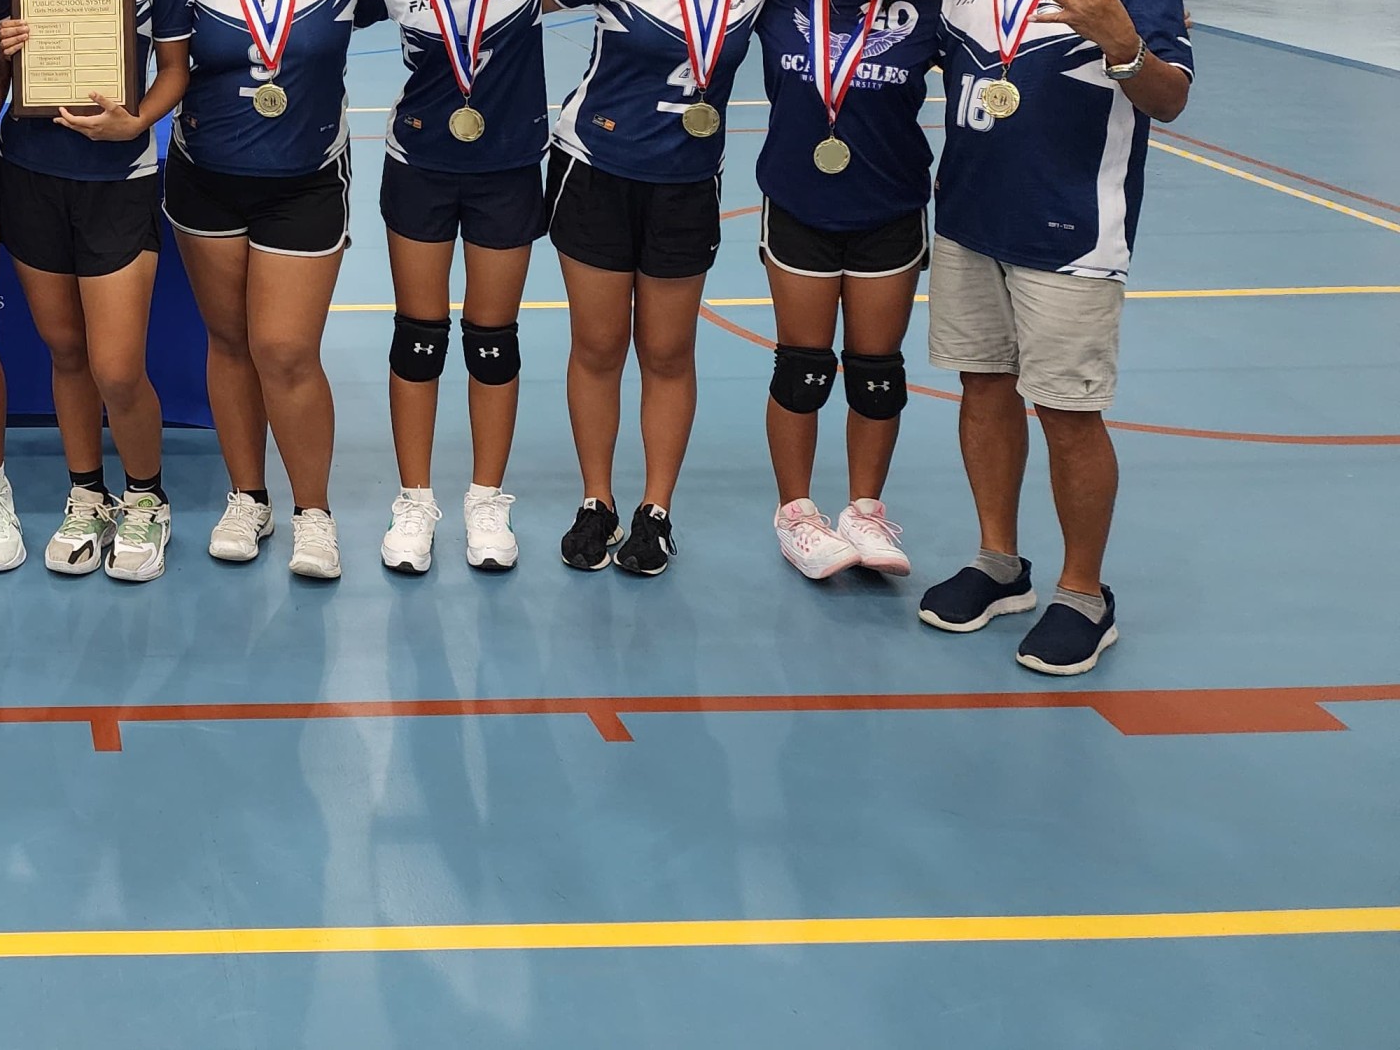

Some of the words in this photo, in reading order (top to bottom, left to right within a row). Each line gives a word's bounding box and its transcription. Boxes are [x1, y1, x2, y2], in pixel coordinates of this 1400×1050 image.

[248, 43, 283, 82] 9
[666, 58, 699, 97] 4
[850, 82, 883, 90] ARSITY
